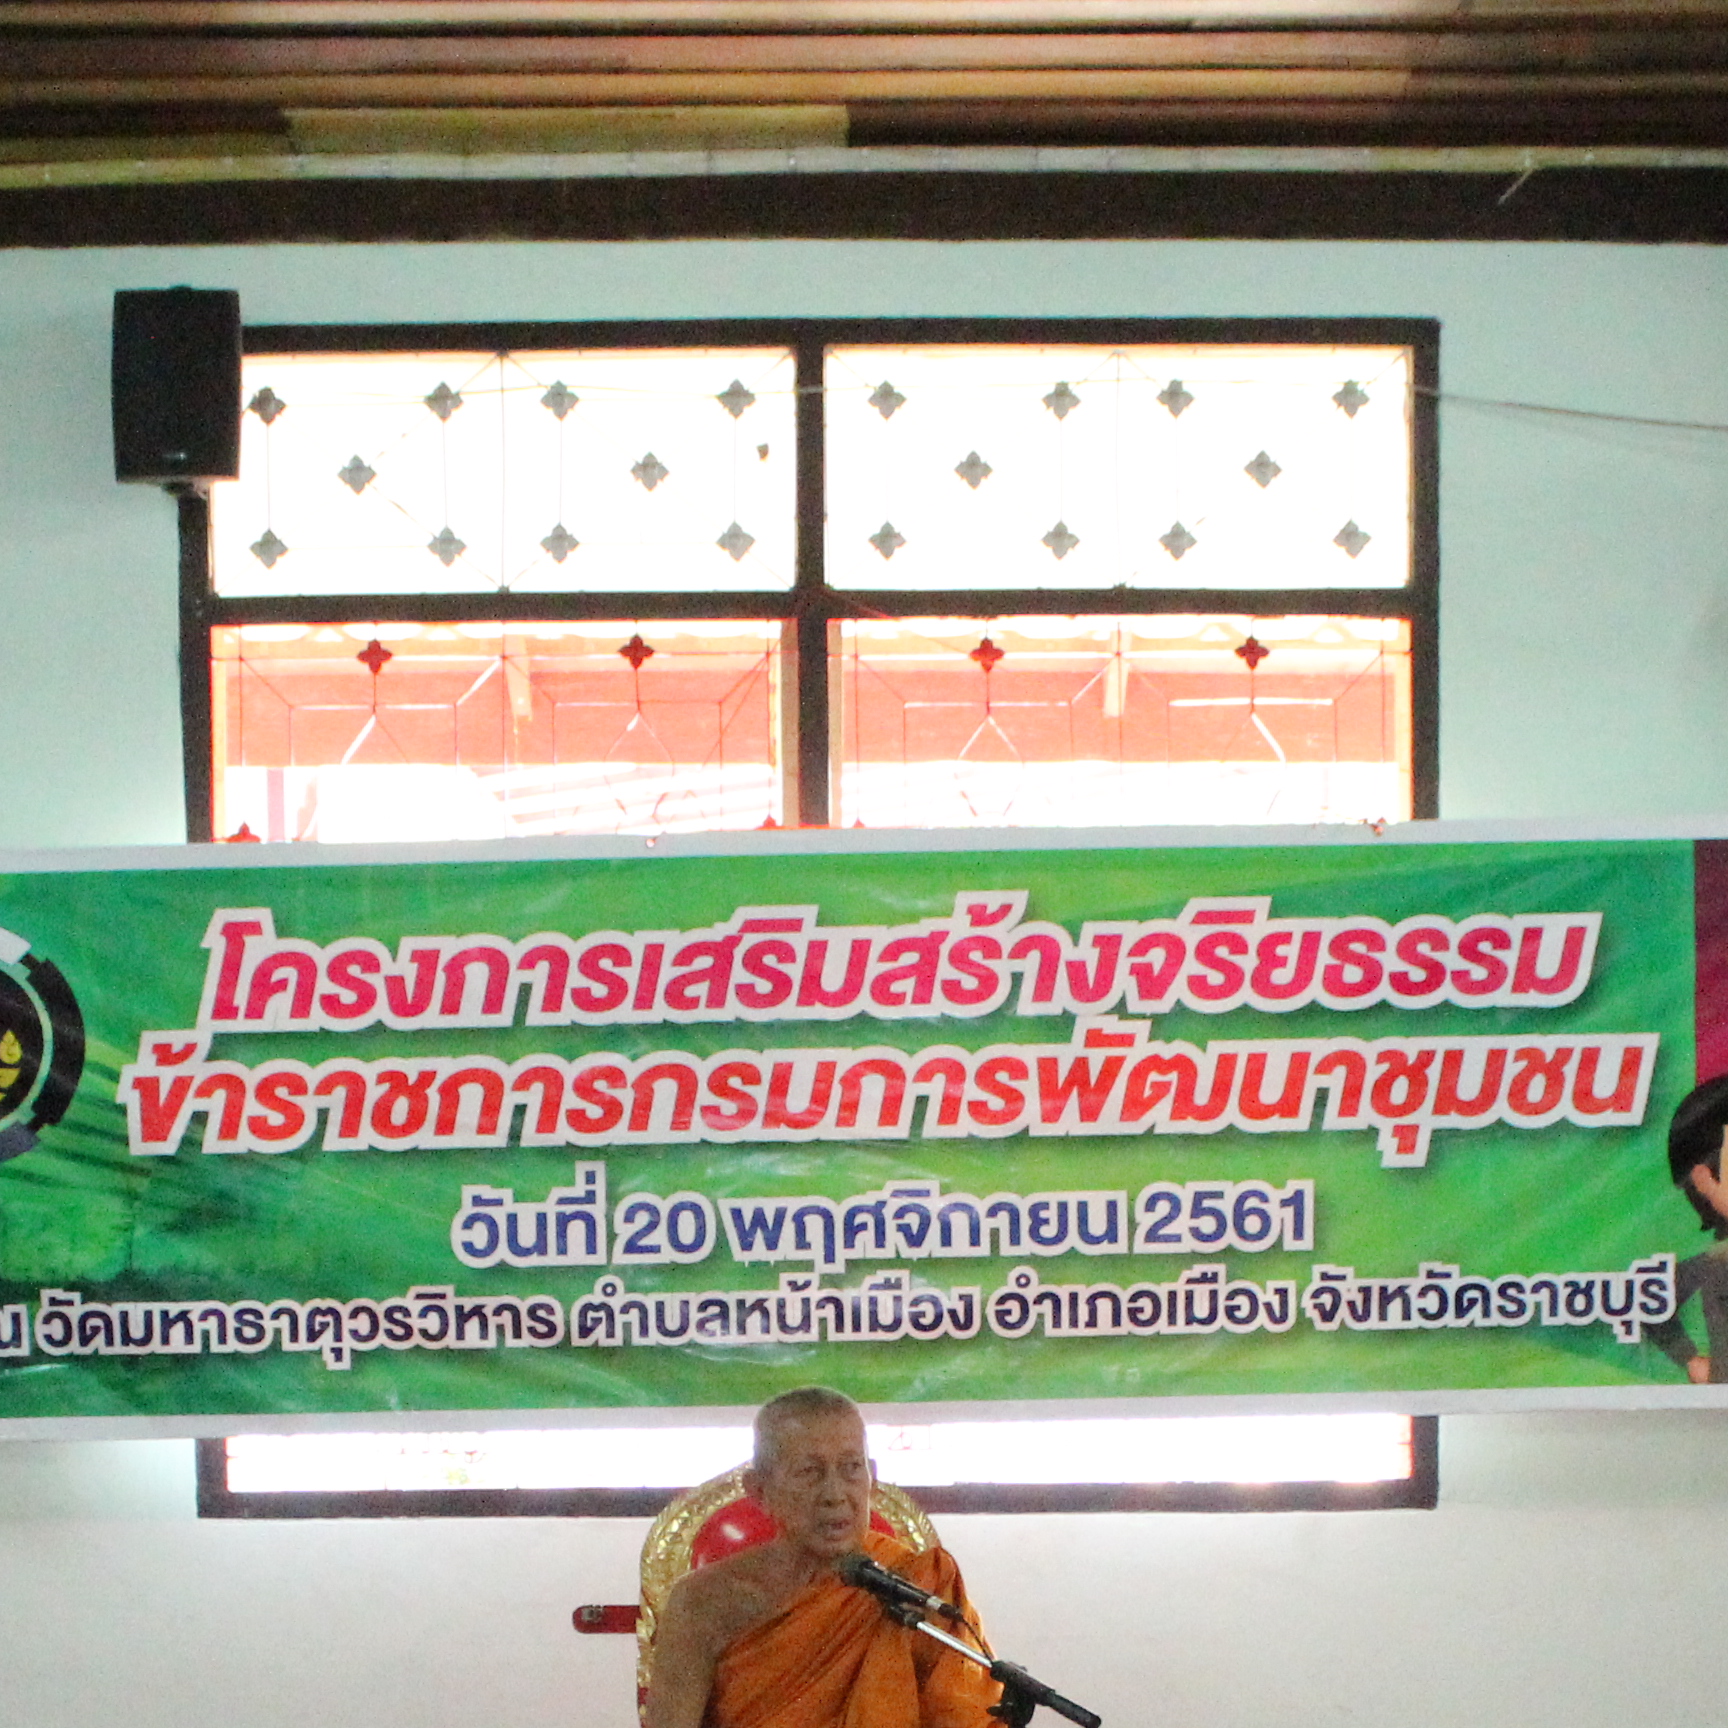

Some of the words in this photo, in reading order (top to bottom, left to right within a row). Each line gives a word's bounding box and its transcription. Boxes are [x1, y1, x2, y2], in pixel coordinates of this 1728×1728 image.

[210, 903, 1588, 1021] โครงการเสริมสร้างจริยธรรม
[131, 1025, 1645, 1156] ข้าราชการกรมการพัฒนาชุมชน
[459, 1168, 597, 1258] วันที่
[622, 1199, 707, 1255] 20
[733, 1185, 1120, 1264] พฤศจิกายน
[1142, 1186, 1306, 1244] 2561
[42, 1292, 558, 1362] วัดมหาธาตุวรวิหาร
[578, 1276, 974, 1341] ตำบลหน้าเมือง
[995, 1266, 1289, 1329] อำเภอเมือง
[1311, 1259, 1669, 1338] จังหวัดราชบุรี
